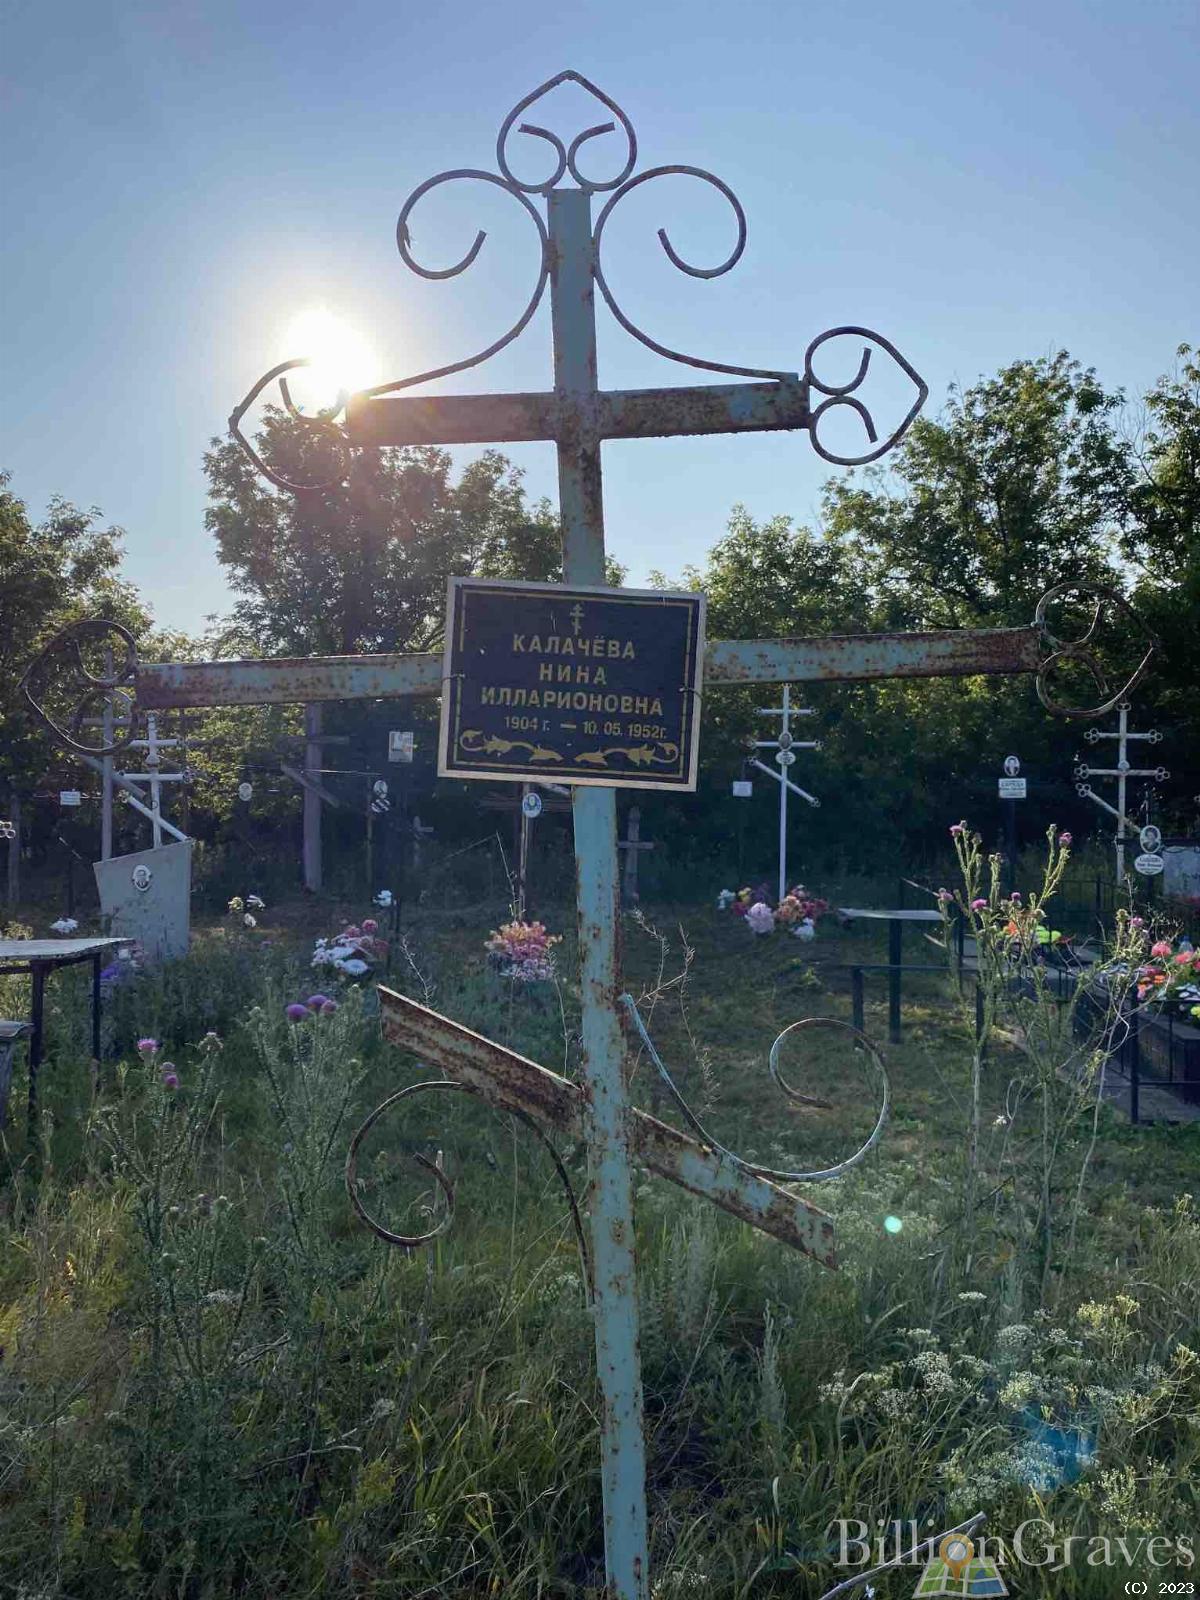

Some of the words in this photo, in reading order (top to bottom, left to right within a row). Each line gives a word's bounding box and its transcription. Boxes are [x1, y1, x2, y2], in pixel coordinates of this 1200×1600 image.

[513, 634, 636, 659] КАЛАЧЁВА
[539, 663, 607, 685] НИНА
[481, 686, 664, 716] ИЛЛАРИОНОВНА
[504, 716, 538, 731] 1904
[583, 721, 599, 735] 10.
[604, 722, 623, 737] 05.
